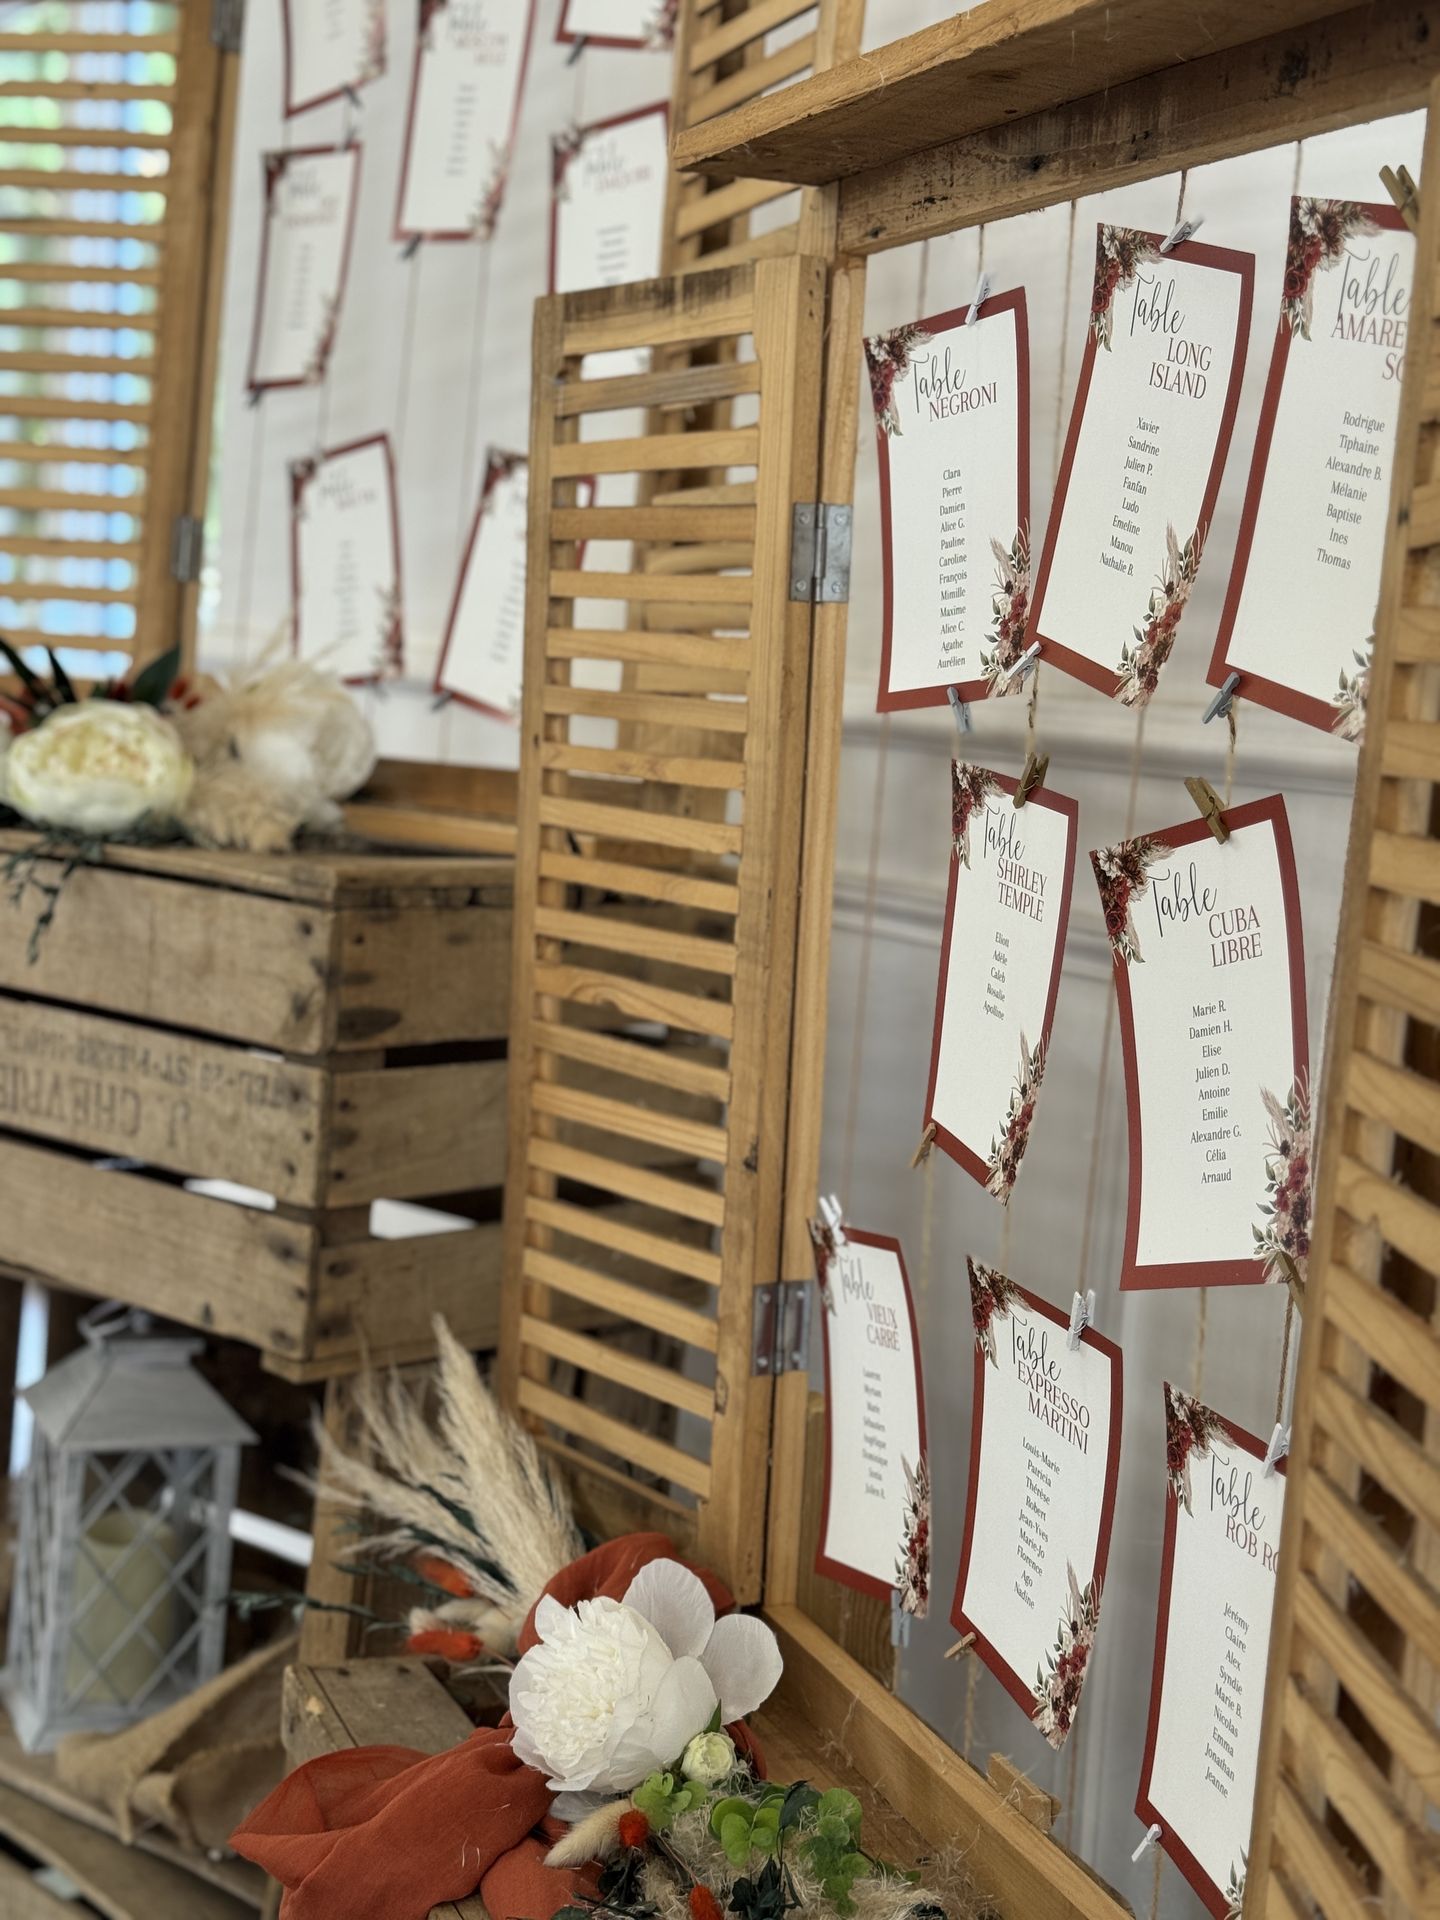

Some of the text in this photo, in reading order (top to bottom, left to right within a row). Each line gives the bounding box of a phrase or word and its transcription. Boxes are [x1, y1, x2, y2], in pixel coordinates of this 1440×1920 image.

[1338, 248, 1408, 323] Table
[1130, 275, 1185, 336] Table
[1167, 337, 1212, 371] LONG
[910, 347, 966, 413] Table
[1149, 362, 1206, 399] ISLAND
[930, 382, 997, 422] NEGRONI
[1137, 417, 1159, 434] Xavier
[1343, 411, 1385, 433] Rodrigue
[1128, 436, 1159, 456] Sandrine
[1339, 435, 1379, 456] Tiphaine
[943, 468, 960, 480] Clara
[1124, 456, 1152, 476] Julien P.
[1325, 456, 1382, 481] Alexandre B.
[942, 485, 962, 498] Pierre
[1123, 477, 1147, 495] Fanfan
[1331, 481, 1367, 501] Mélanie
[940, 502, 965, 516] Damien
[1122, 498, 1139, 513] Ludo
[1327, 504, 1362, 524] Baptiste
[941, 521, 956, 533] Alice
[1113, 515, 1140, 535] Emeline
[1330, 528, 1348, 544] Ines
[941, 536, 965, 550] Pauline
[1110, 535, 1133, 554] Manou
[939, 554, 967, 568] Caroline
[1100, 553, 1134, 576] Nathalie B.
[1317, 548, 1351, 570] Thomas
[939, 570, 967, 585] François
[941, 588, 966, 601] Mimille
[940, 605, 966, 617] Maxime
[941, 623, 957, 635] Alice
[941, 639, 963, 653] Agathe
[938, 657, 965, 669] Aurélien
[983, 802, 1025, 860] Table
[997, 858, 1047, 896] SHIRLEY
[999, 882, 1044, 922] TEMPLE
[1146, 862, 1217, 938] Table
[1209, 905, 1260, 938] CUBA
[1211, 932, 1262, 968] LIBRE
[1193, 1000, 1226, 1018] Marie R.
[1189, 1020, 1232, 1039] Damien H.
[1202, 1044, 1221, 1058] Elise
[1195, 1063, 1230, 1083] Julien D.
[1198, 1086, 1230, 1101] Antoine
[1202, 1107, 1228, 1121] Emilie
[1191, 1128, 1231, 1144] Alexandre
[1206, 1149, 1226, 1163] Célia
[1201, 1169, 1231, 1184] Arnaud
[1009, 1310, 1061, 1381] Table
[1018, 1360, 1090, 1428] EXPRESSO
[1028, 1391, 1088, 1454] MARTINI
[1022, 1437, 1060, 1475] Louis-Marie
[1028, 1459, 1051, 1487] Patricia
[1026, 1476, 1050, 1505] Thérèse
[1210, 1447, 1265, 1530] Table
[1026, 1495, 1046, 1521] Robert
[1019, 1509, 1049, 1543] Jean-Yves
[1226, 1515, 1257, 1557] ROB
[1017, 1545, 1042, 1577] Florence
[1014, 1582, 1035, 1609] Nadine
[1223, 1602, 1249, 1635] Jérémy
[1225, 1626, 1246, 1653] Claire
[1226, 1650, 1241, 1671] Alex
[1220, 1665, 1243, 1695] Syndie
[1215, 1684, 1242, 1718] Marie B.
[1214, 1705, 1238, 1738] Nicolas
[1213, 1727, 1234, 1757] Emma
[1205, 1743, 1235, 1782] Jonathan
[1205, 1767, 1228, 1798] Jeanne
